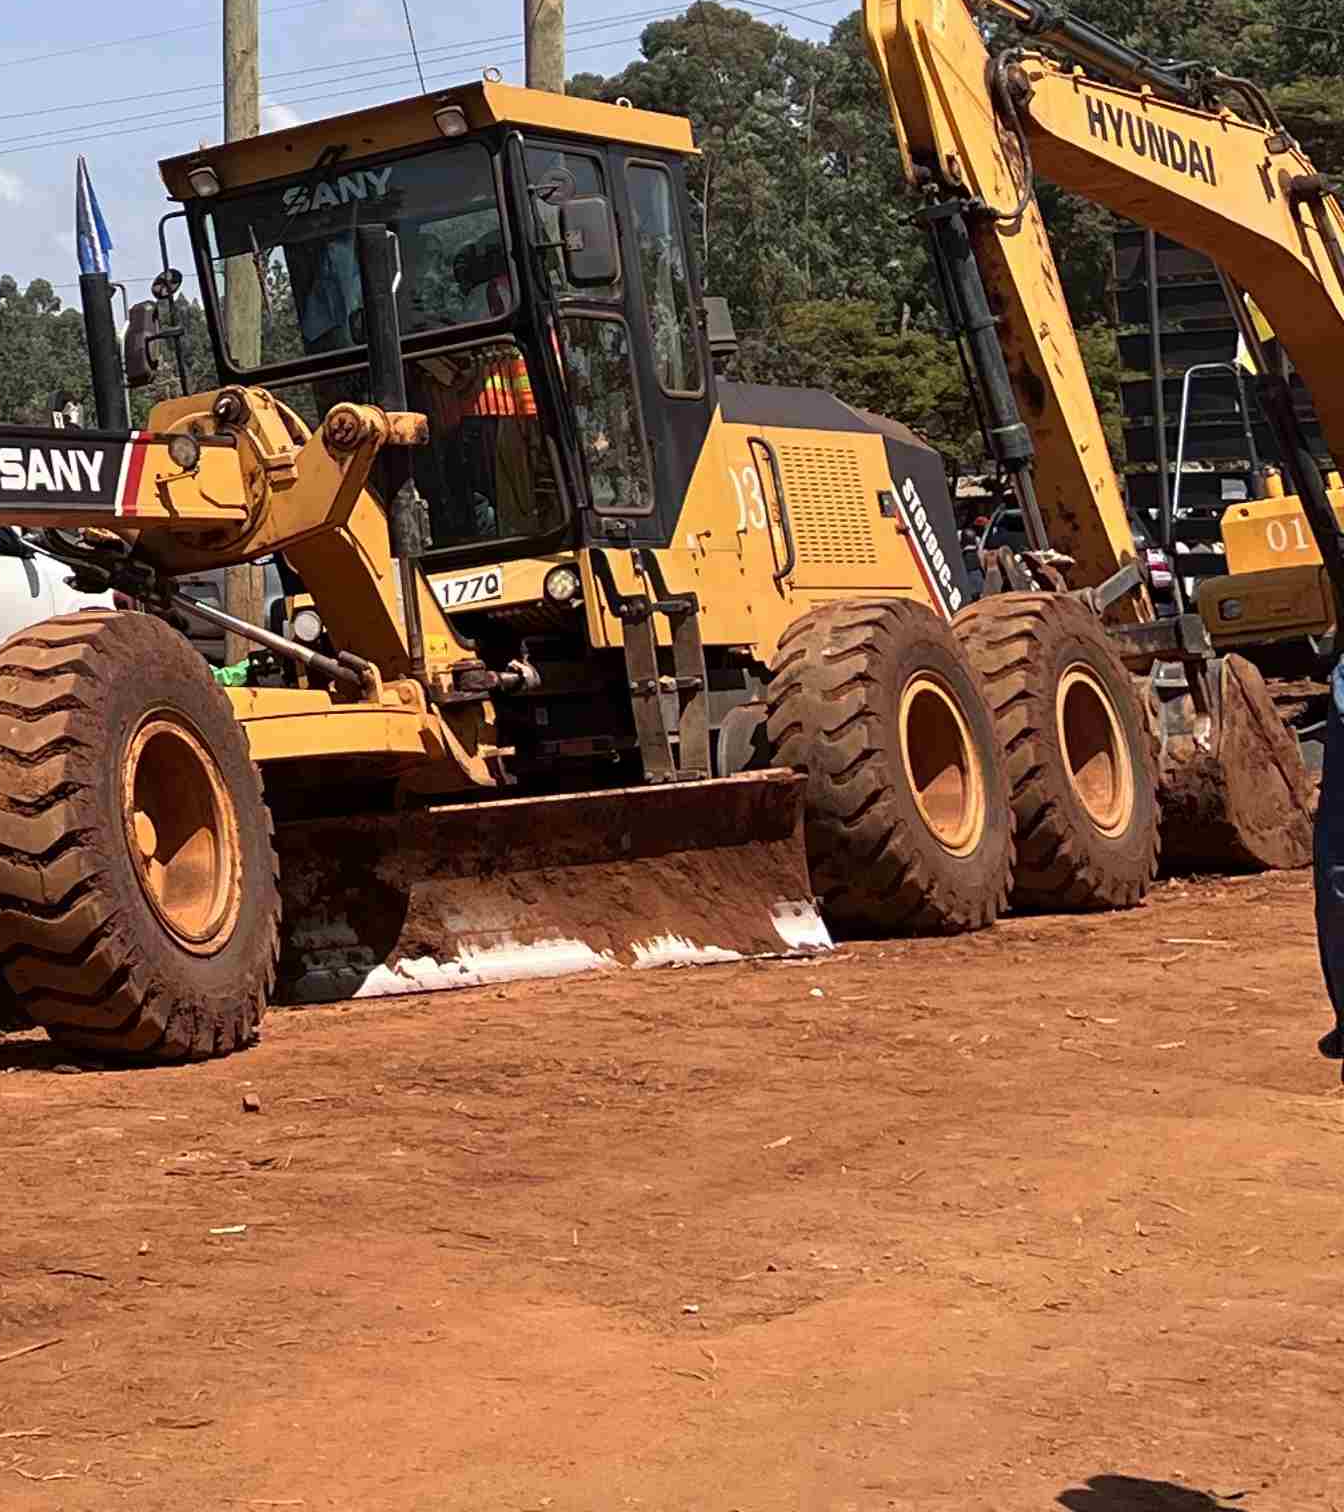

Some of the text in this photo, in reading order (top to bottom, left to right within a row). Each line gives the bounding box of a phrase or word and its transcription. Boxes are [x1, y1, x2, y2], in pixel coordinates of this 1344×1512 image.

[1085, 95, 1217, 187] HYUNDAI
[282, 167, 392, 216] SANY
[1266, 518, 1310, 553] 01
